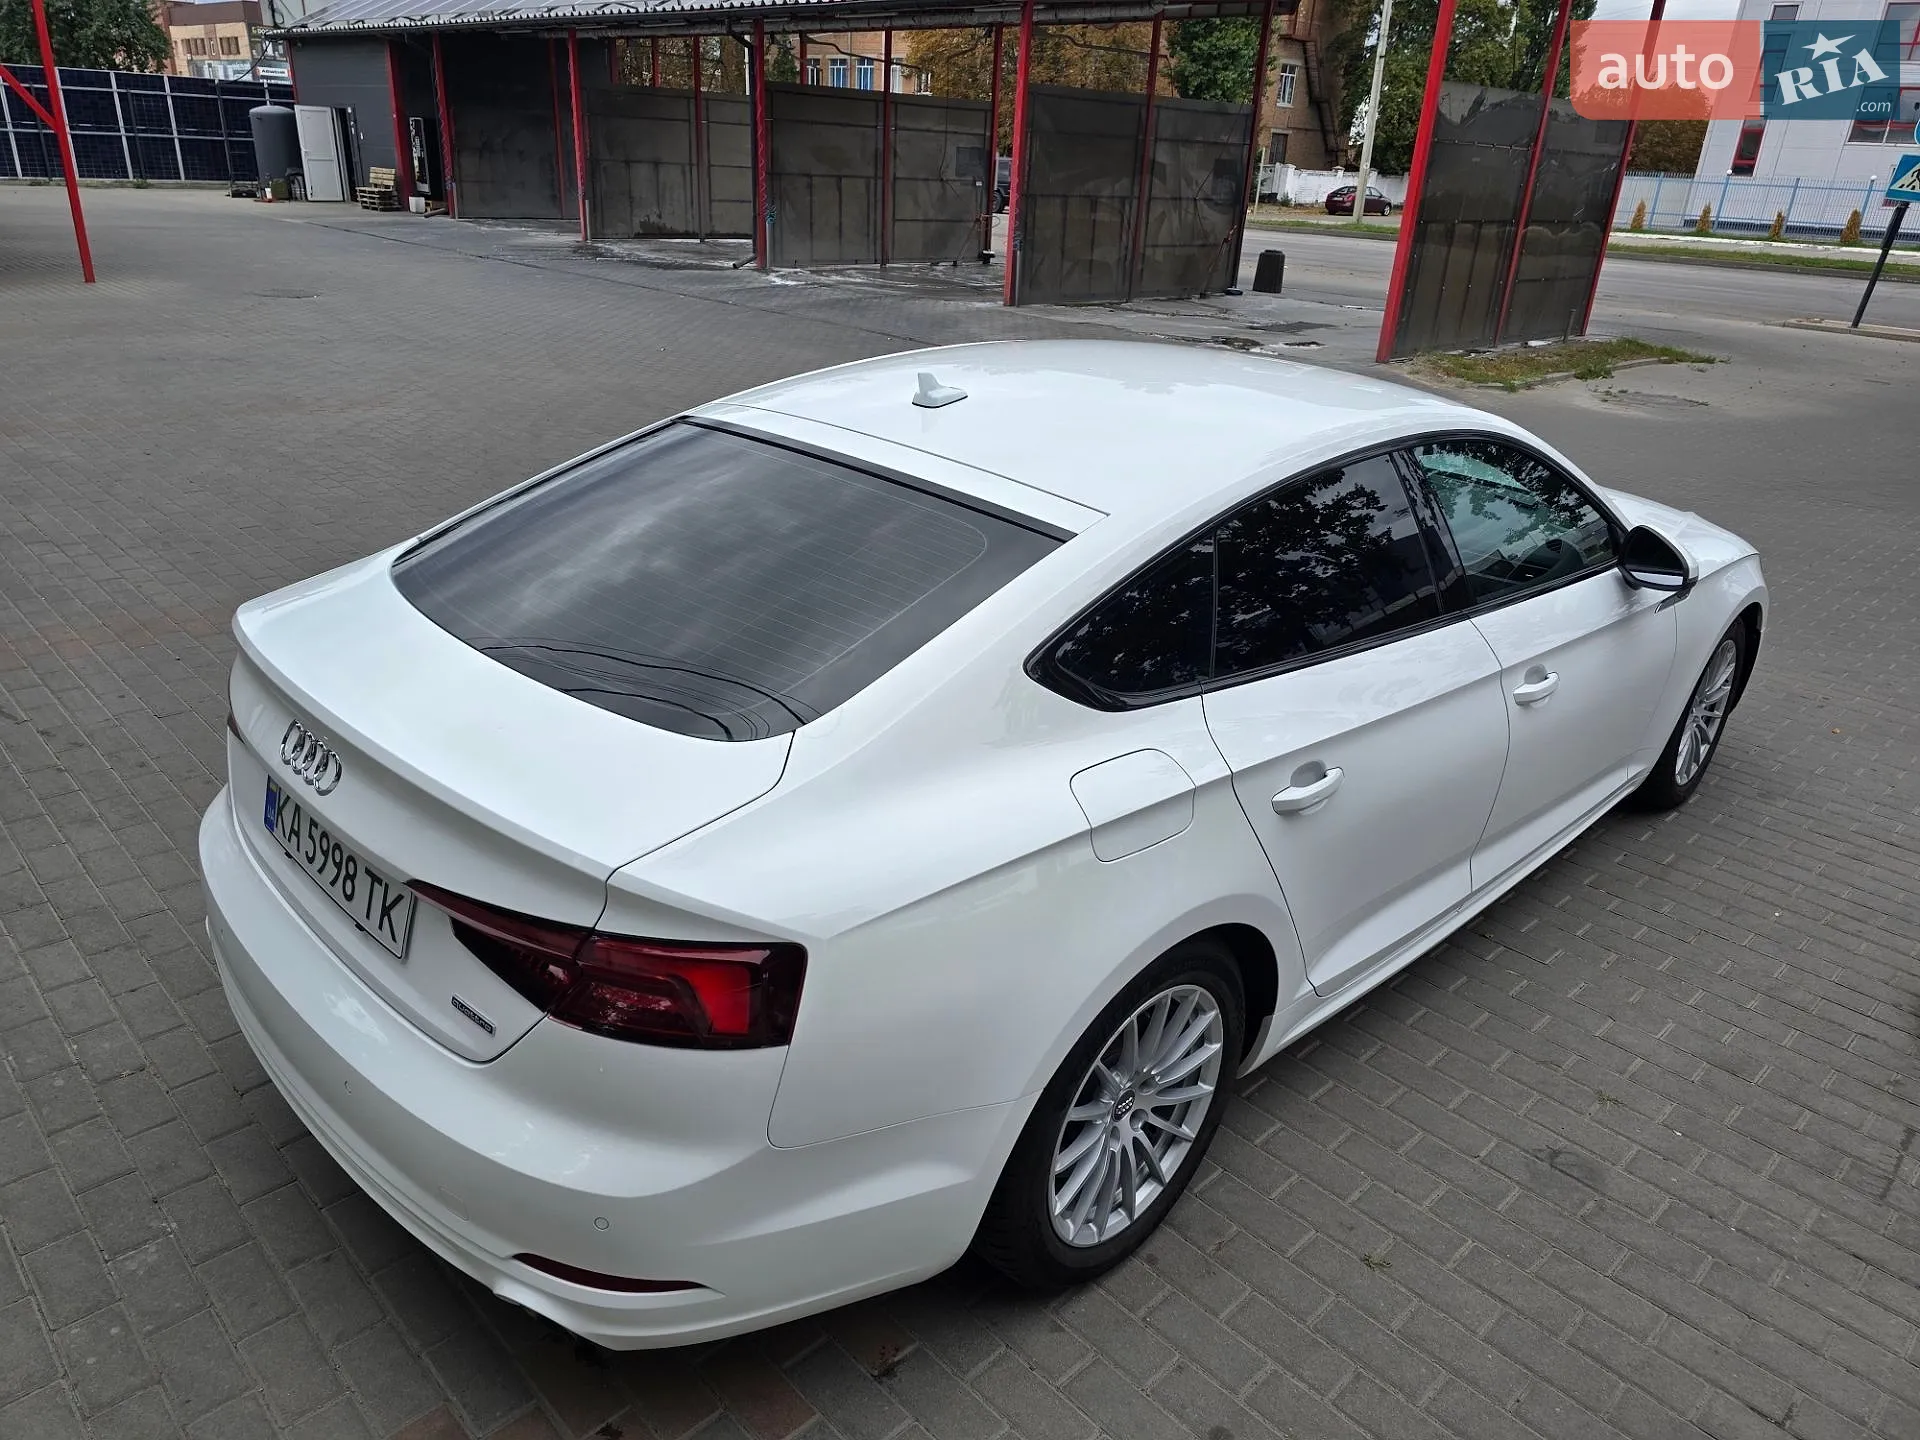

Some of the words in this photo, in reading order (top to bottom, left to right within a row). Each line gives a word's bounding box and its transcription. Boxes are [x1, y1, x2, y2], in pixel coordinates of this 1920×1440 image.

[275, 786, 301, 853] KA
[305, 816, 358, 902] 5998
[364, 866, 404, 943] TK
